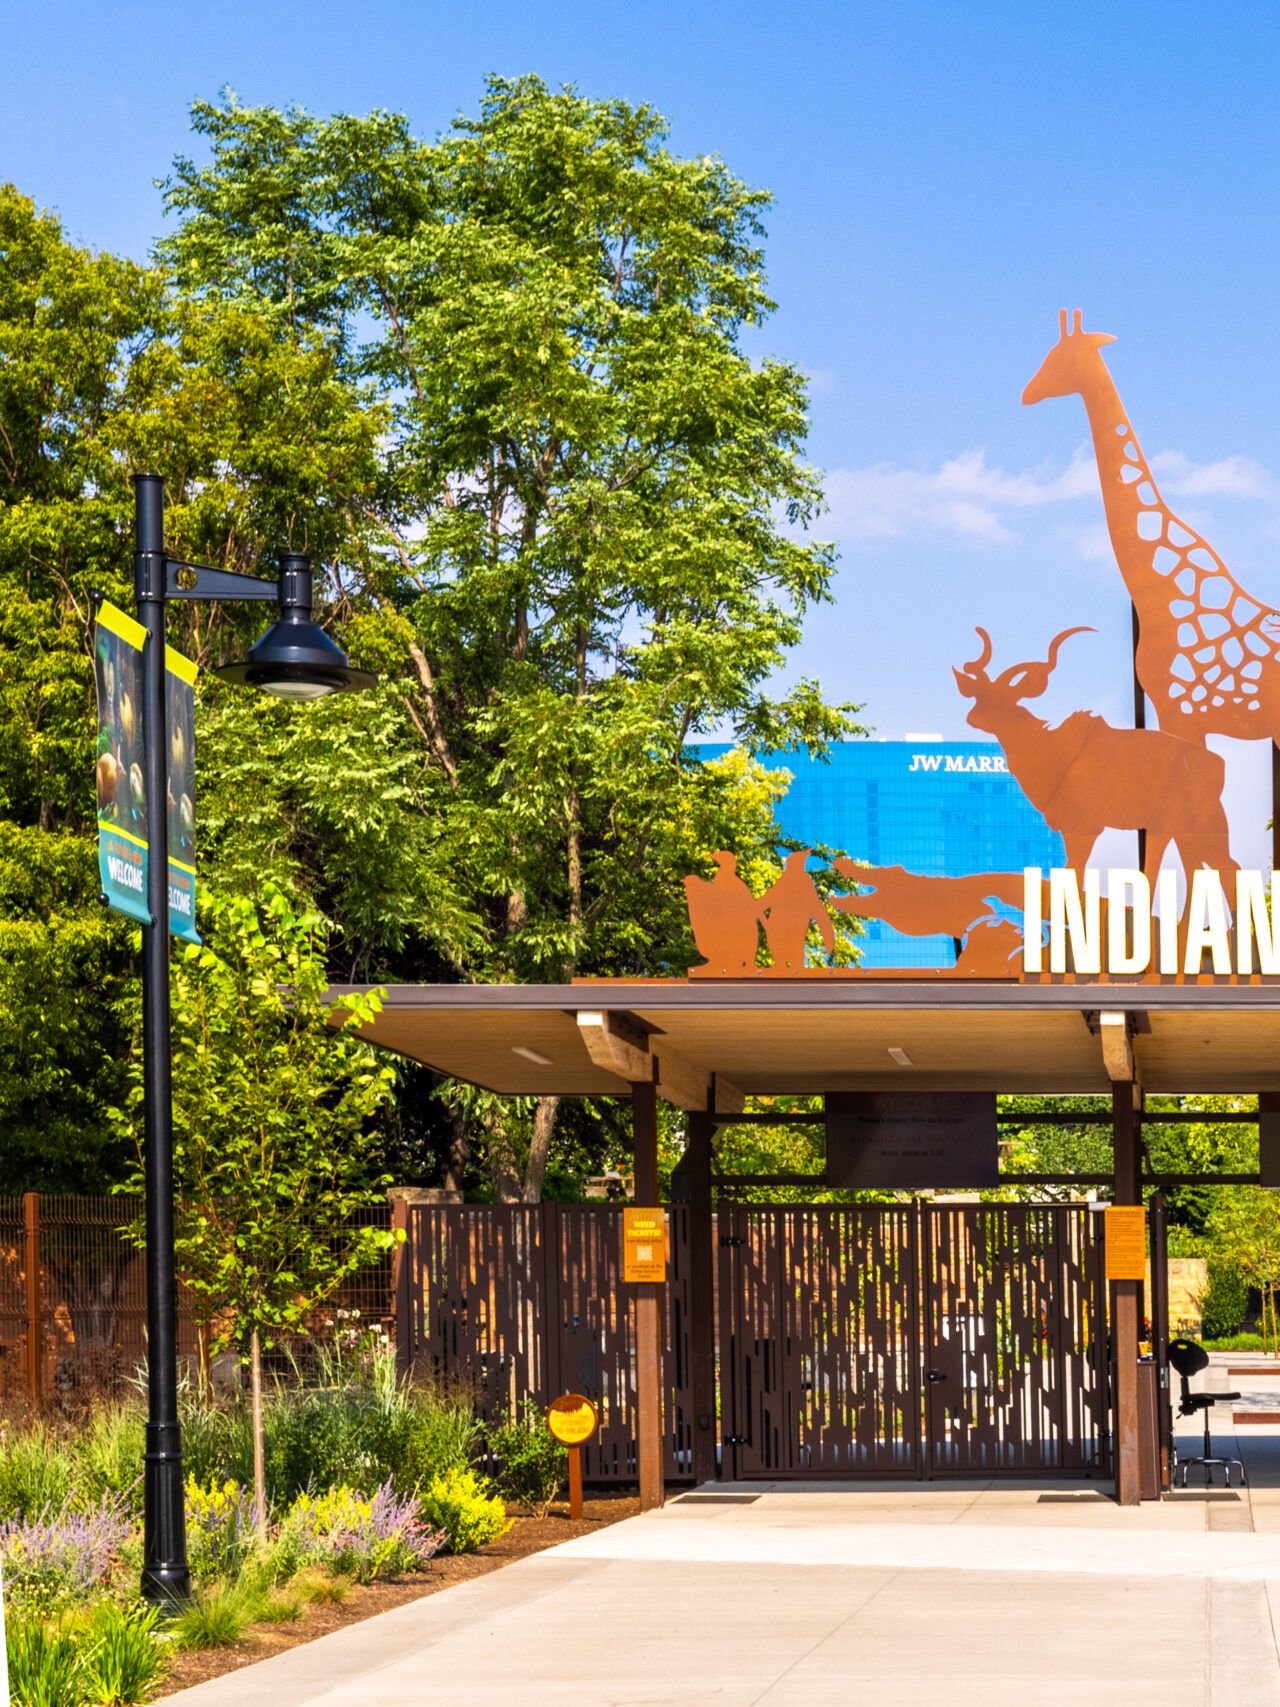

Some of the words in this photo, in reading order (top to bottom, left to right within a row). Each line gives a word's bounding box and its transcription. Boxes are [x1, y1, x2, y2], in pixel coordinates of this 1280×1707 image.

[909, 755, 942, 771] JW
[944, 756, 1009, 772] MARR
[107, 855, 143, 893] WELCOME
[168, 886, 191, 915] LCOME
[872, 1096, 950, 1110] WELCOME
